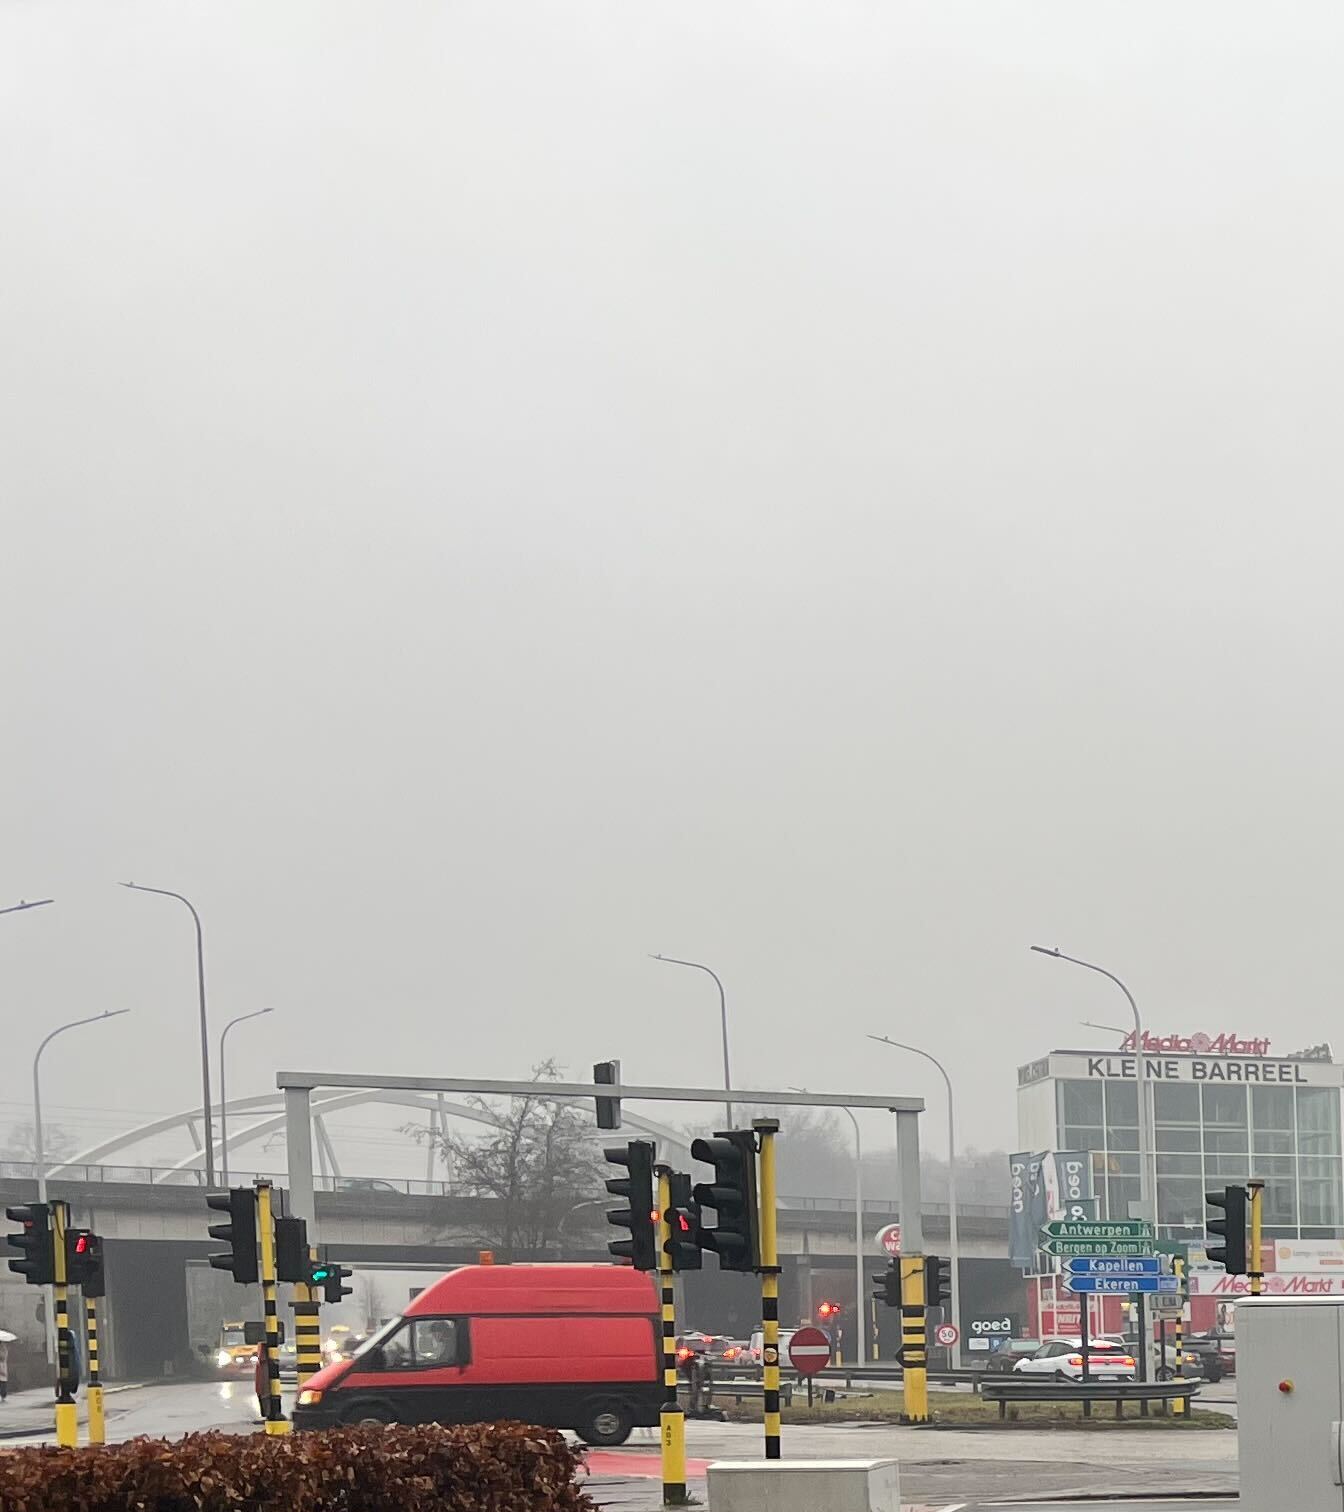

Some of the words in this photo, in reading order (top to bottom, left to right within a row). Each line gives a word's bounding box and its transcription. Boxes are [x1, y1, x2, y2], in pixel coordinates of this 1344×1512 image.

[1208, 1033, 1271, 1054] Markt
[1088, 1058, 1180, 1079] KLENE
[1192, 1062, 1308, 1083] BARREEL
[1059, 1223, 1131, 1237] Antwerpen
[1055, 1241, 1093, 1256] Bergen
[1095, 1244, 1107, 1255] op
[1109, 1240, 1138, 1252] Zoom
[1089, 1258, 1144, 1273] Kapellen
[1095, 1278, 1139, 1291] Ekeren
[1283, 1276, 1334, 1294] Markt
[941, 1327, 955, 1339] 50
[971, 1317, 1011, 1335] goed
